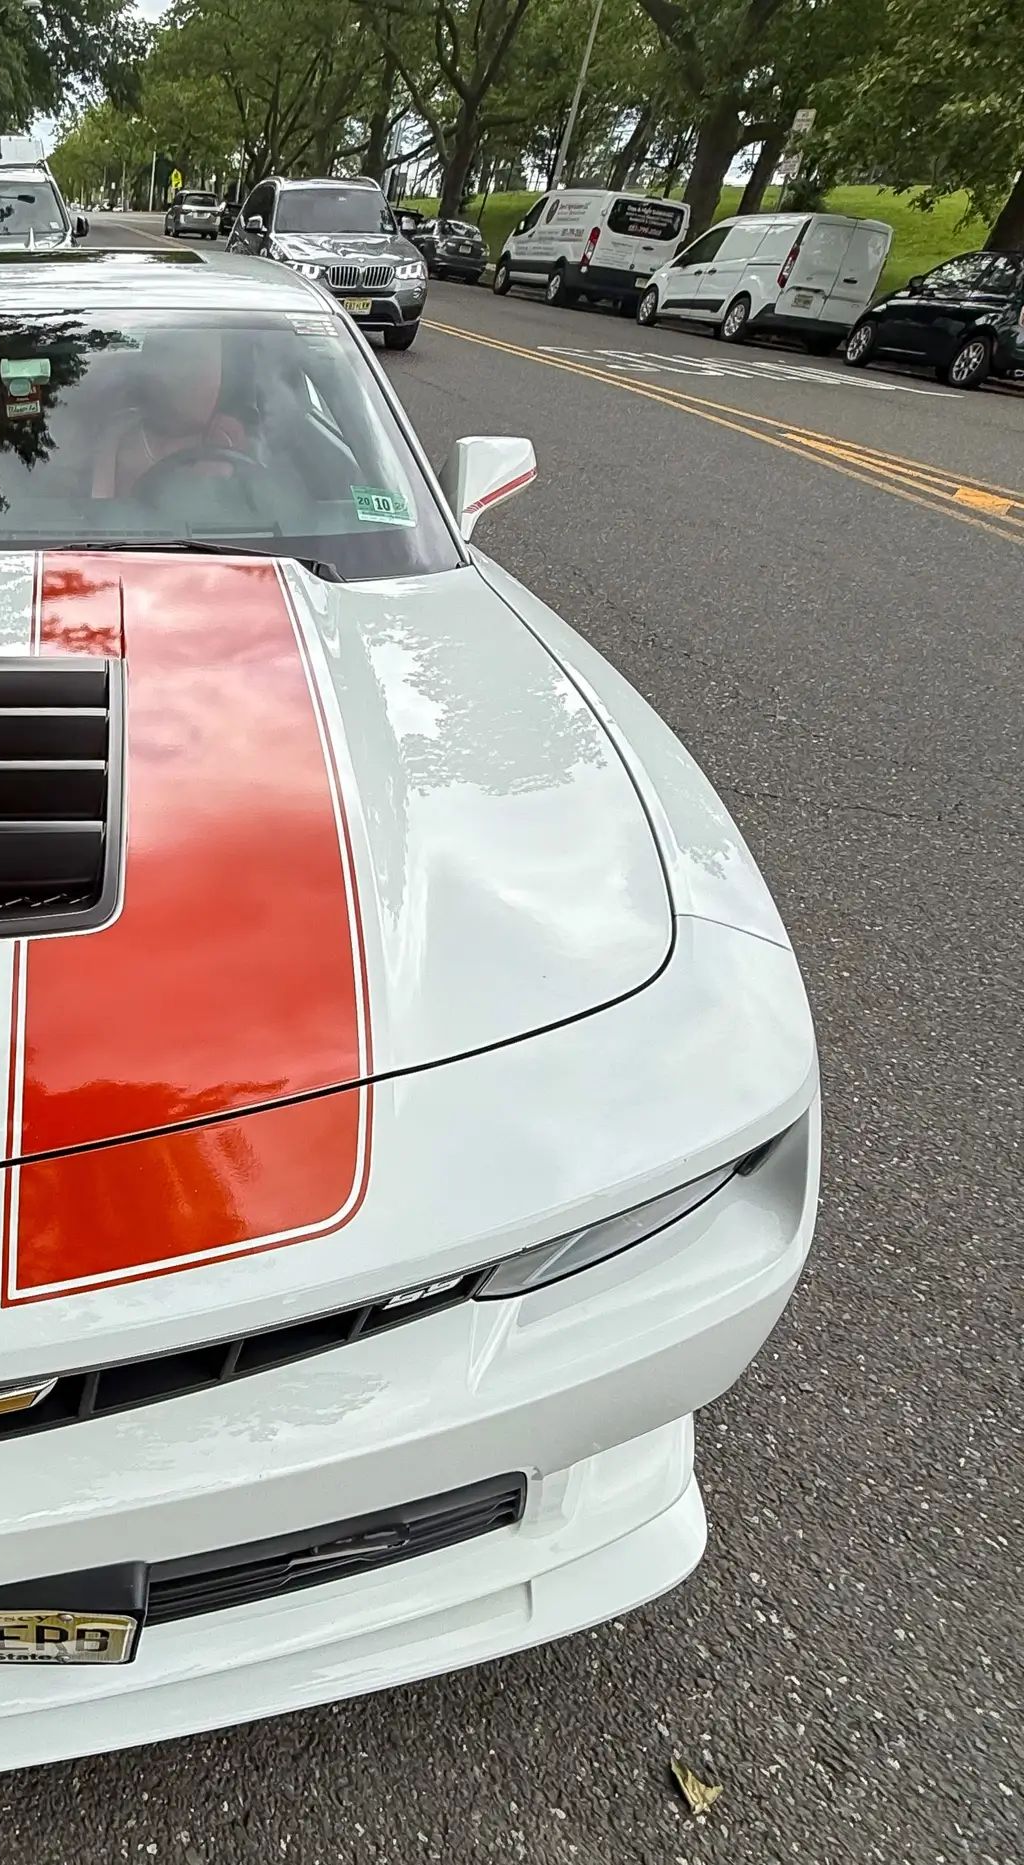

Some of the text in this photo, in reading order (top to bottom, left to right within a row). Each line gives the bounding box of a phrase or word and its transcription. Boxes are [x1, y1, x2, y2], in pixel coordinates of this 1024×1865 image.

[357, 496, 370, 505] 20
[375, 498, 391, 512] 10
[382, 1275, 464, 1310] SS
